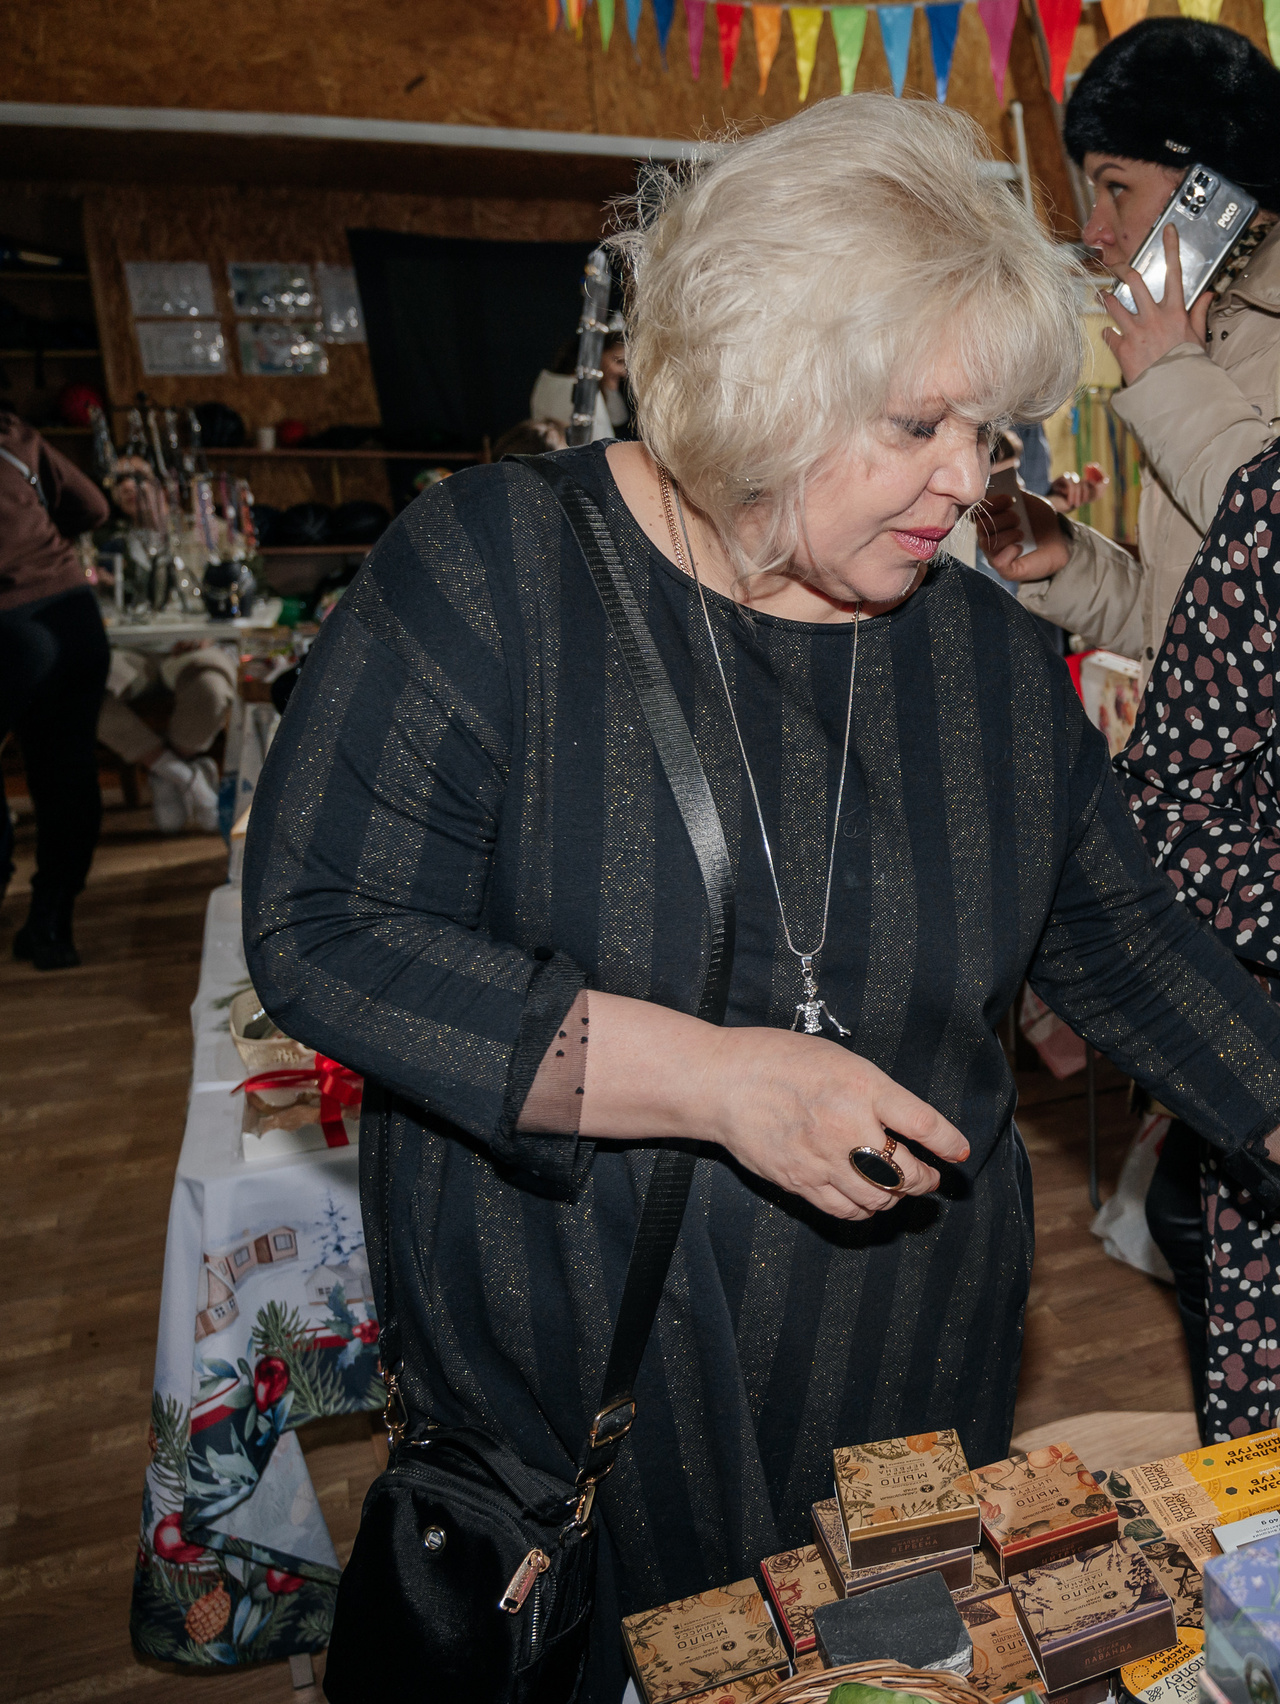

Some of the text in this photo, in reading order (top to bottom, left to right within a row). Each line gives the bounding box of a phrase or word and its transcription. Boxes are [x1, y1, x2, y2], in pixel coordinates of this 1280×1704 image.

[1217, 202, 1238, 229] POCO
[1228, 1446, 1251, 1457] ГУБ
[878, 1463, 925, 1475] ВЕРБЕНА
[880, 1472, 928, 1486] МЫЛО
[1140, 1464, 1161, 1490] sunny
[1151, 1462, 1174, 1487] honey
[1009, 1477, 1052, 1498] ЦИТРУС
[1250, 1474, 1275, 1485] ГУБ
[1016, 1487, 1060, 1507] МЫЛО
[1172, 1491, 1197, 1518] honey
[1162, 1495, 1184, 1521] sunny
[891, 1539, 938, 1553] ВЕРБЕНА
[1057, 1572, 1103, 1591] ЛАВАНДА
[1061, 1580, 1109, 1601] МЫЛО
[675, 1621, 724, 1640] МЕЛИССА
[677, 1627, 728, 1650] МЫЛО
[996, 1639, 1026, 1655] ЫЛО
[1085, 1643, 1132, 1665] ЛАВАНДА
[1147, 1650, 1163, 1664] РУК
[1159, 1644, 1190, 1664] МАСКА
[1150, 1649, 1196, 1680] ВОСКОВАЯ
[1174, 1677, 1198, 1698] nny
